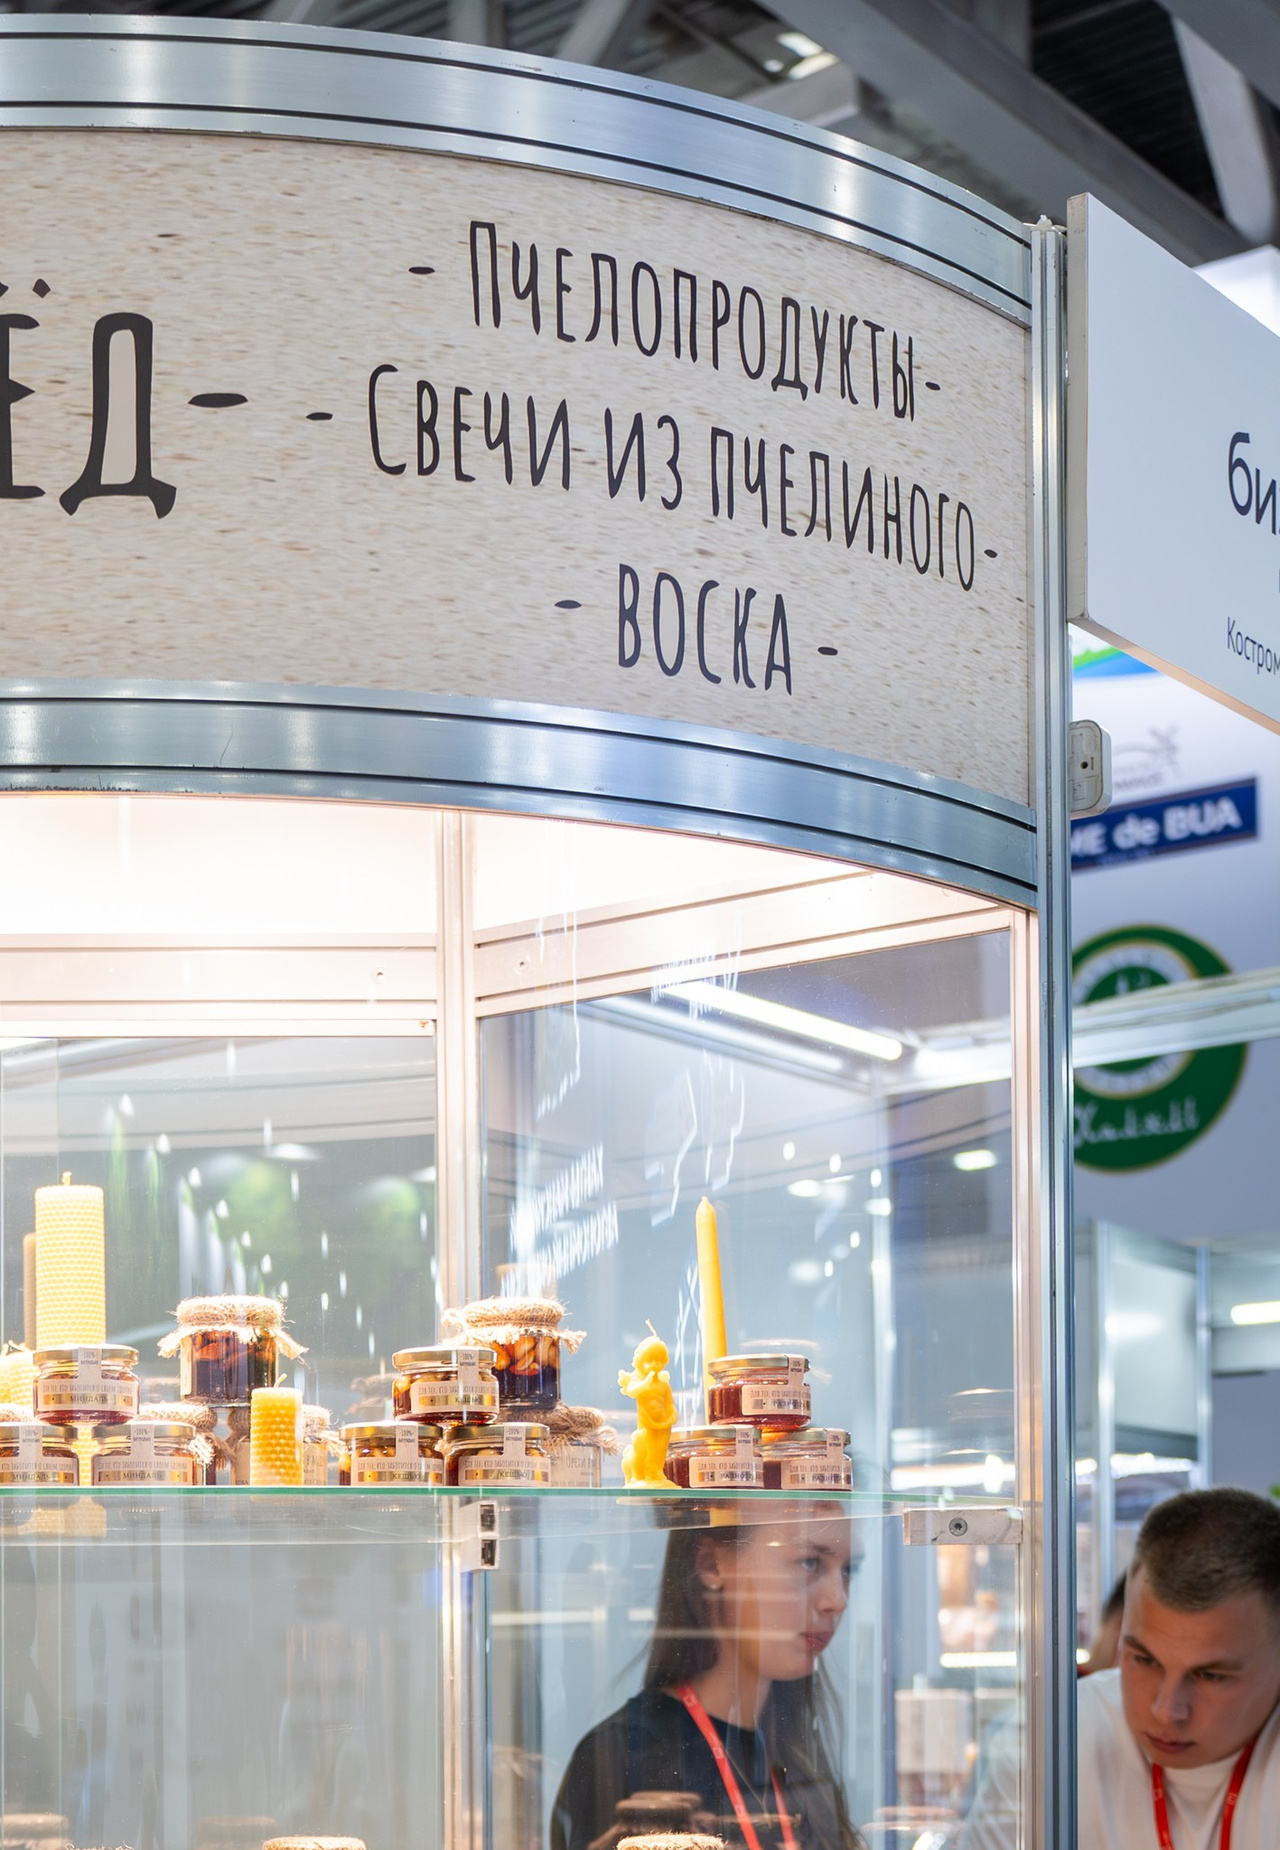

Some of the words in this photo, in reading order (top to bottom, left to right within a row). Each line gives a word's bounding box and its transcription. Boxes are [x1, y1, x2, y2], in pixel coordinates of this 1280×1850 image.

[367, 364, 570, 490] СВЕЧИ
[603, 407, 684, 511] ИЗ
[710, 427, 976, 593] ПЧЕЛИНОГО
[618, 563, 792, 696] ВОСКА
[123, 1471, 162, 1480] МИНДАЛЬ
